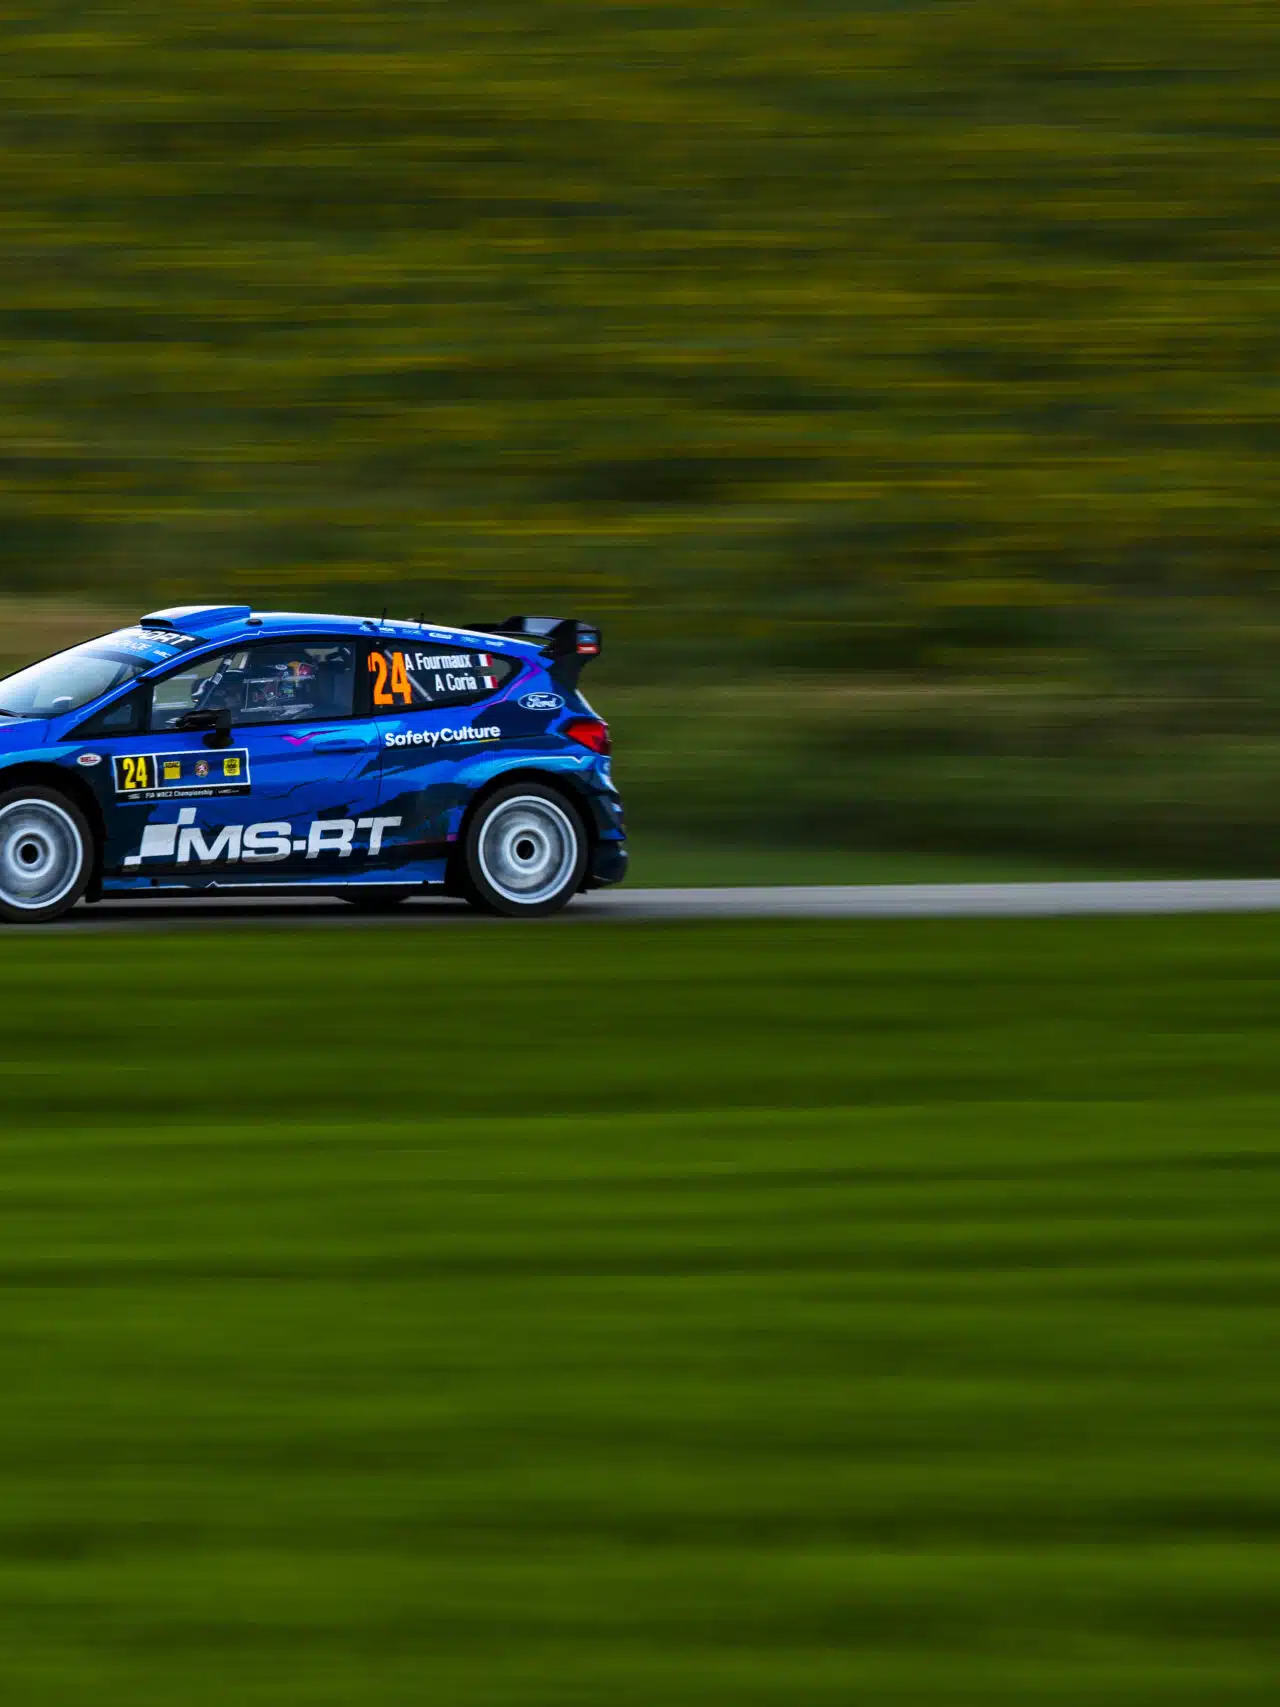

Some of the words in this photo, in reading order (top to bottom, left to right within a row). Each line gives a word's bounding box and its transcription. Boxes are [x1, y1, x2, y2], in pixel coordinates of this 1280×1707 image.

[404, 653, 414, 671] A
[415, 653, 472, 670] Fourmaux
[367, 651, 412, 705] 24
[434, 674, 445, 691] A
[446, 673, 478, 691] Coria
[526, 694, 557, 708] Ford
[385, 726, 501, 748] SafetyCulture
[123, 757, 148, 789] 24
